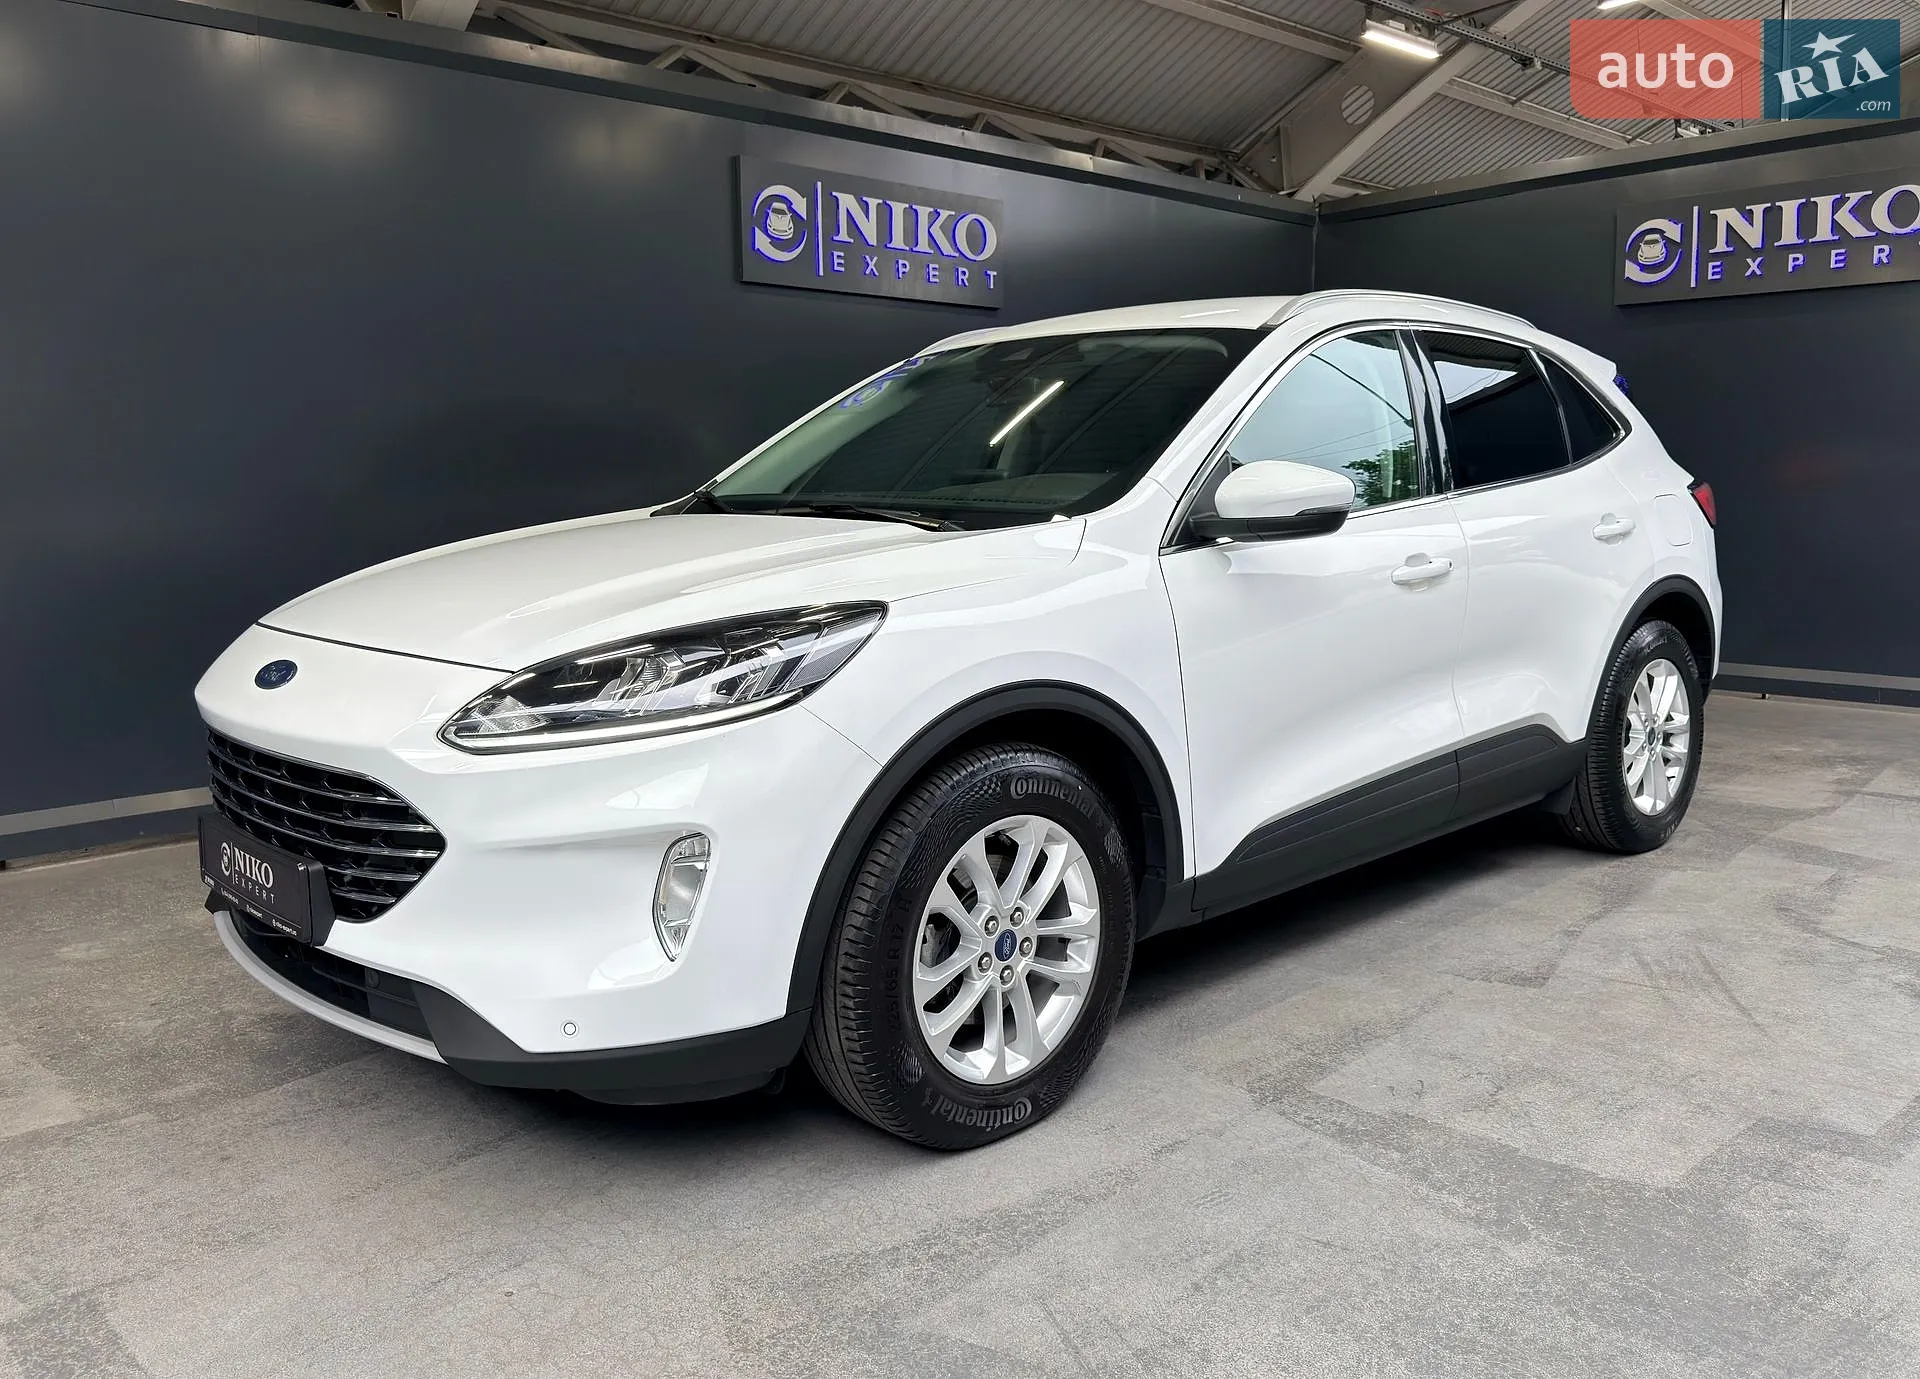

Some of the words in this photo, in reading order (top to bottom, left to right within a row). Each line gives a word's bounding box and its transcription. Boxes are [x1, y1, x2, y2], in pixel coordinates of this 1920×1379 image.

[830, 191, 997, 262] NIKO
[1708, 184, 1920, 254] NIKO
[831, 251, 997, 289] EXPERT
[1707, 240, 1920, 281] EXPER
[1010, 775, 1095, 821] Continental
[234, 846, 274, 888] NIKO
[235, 873, 274, 904] EXPERT
[930, 1095, 1033, 1132] Continental
